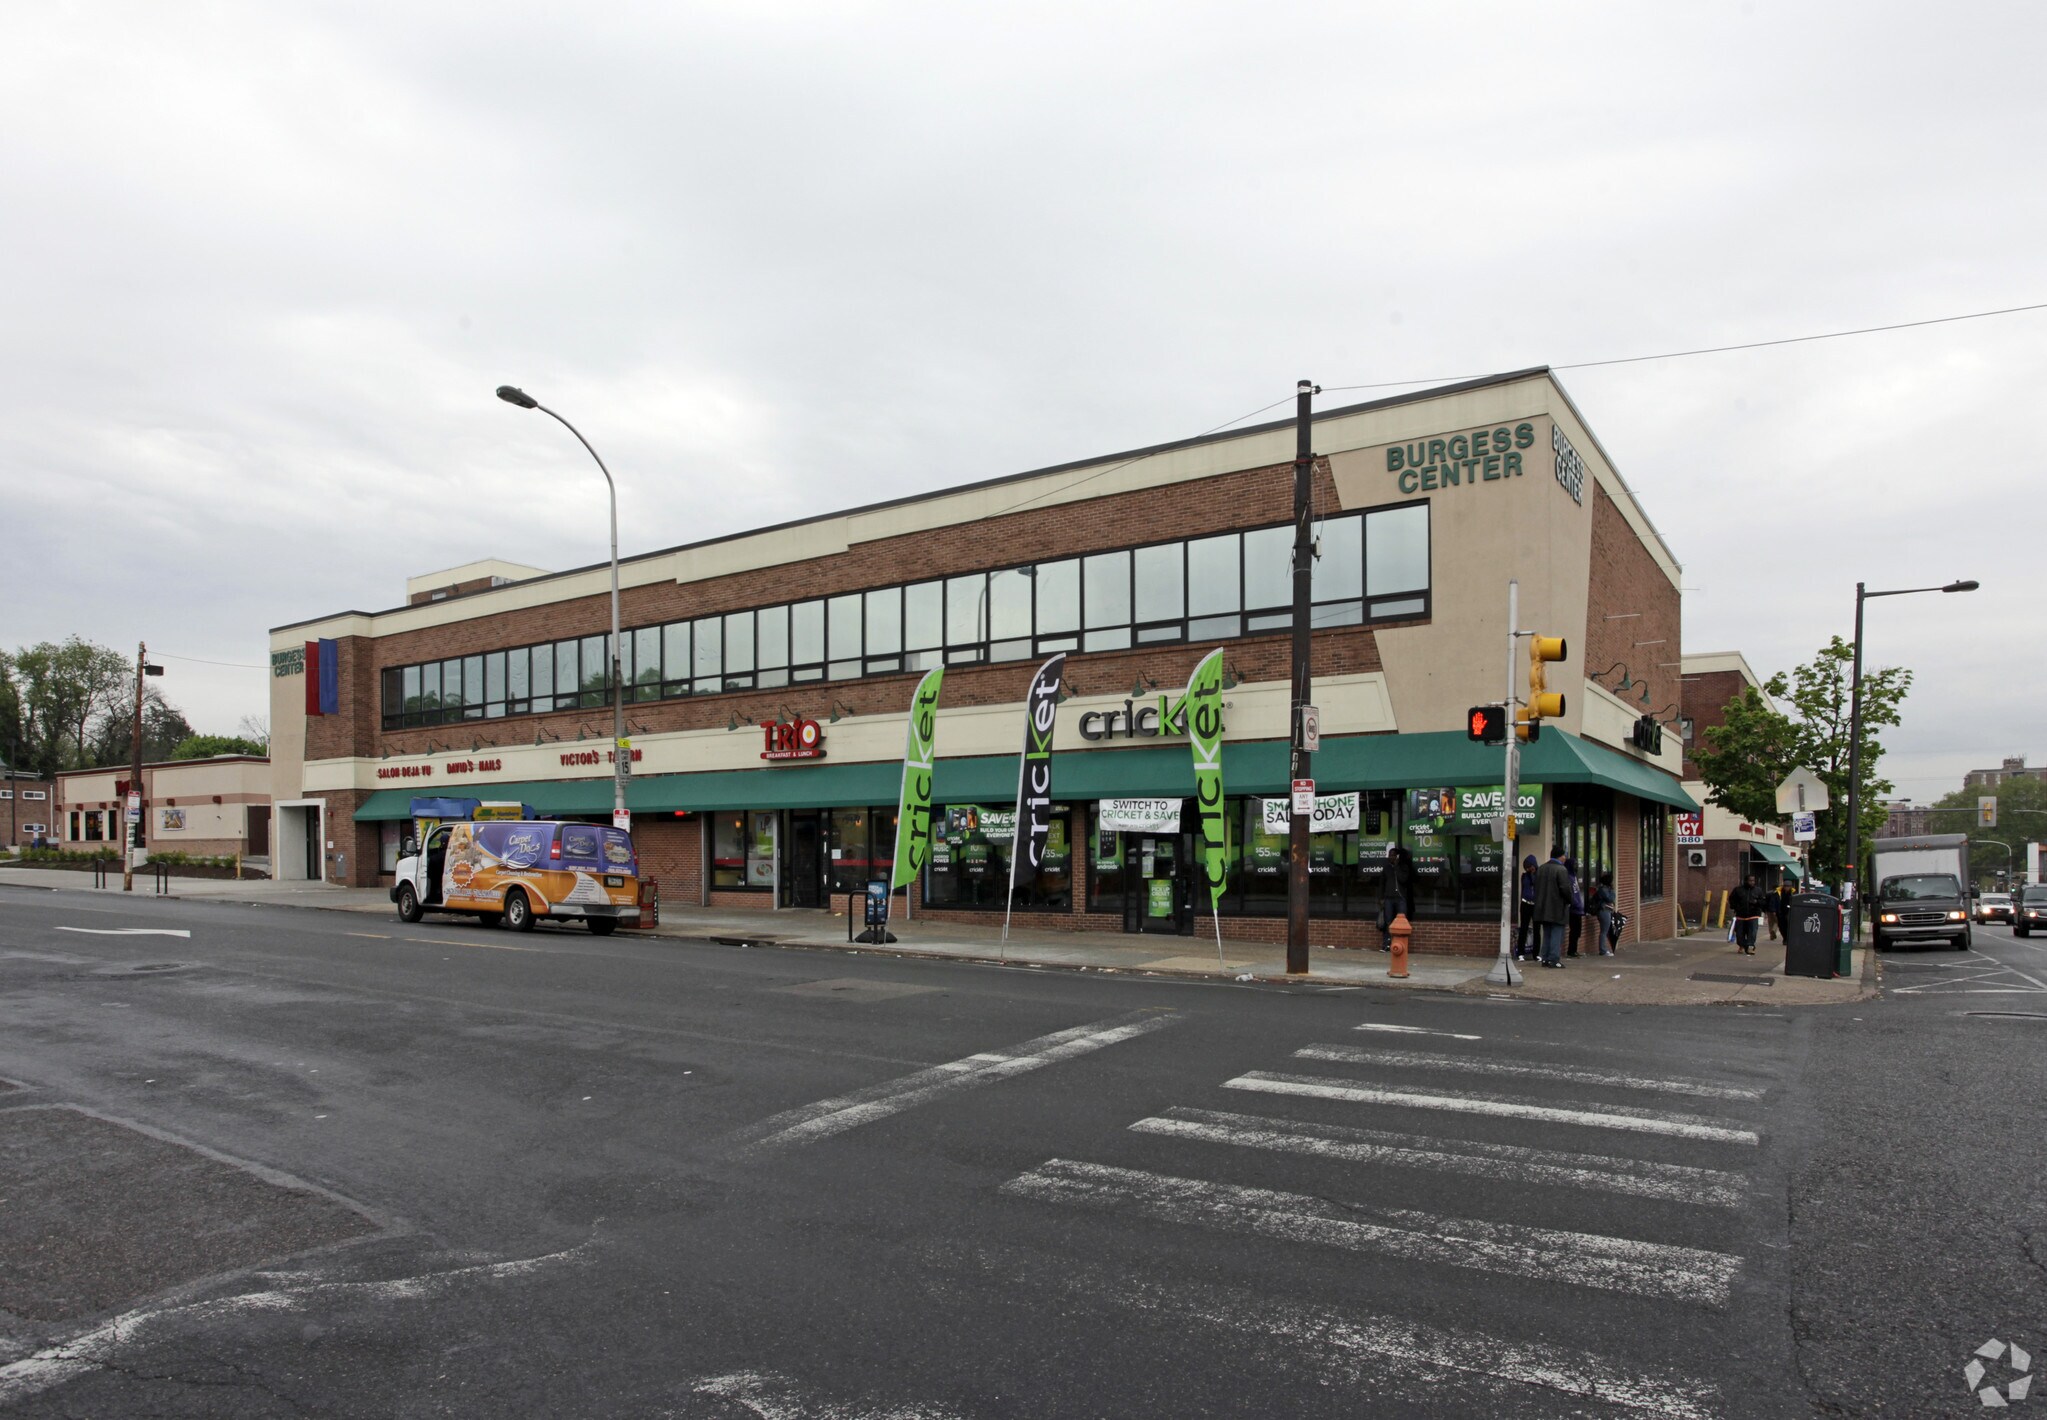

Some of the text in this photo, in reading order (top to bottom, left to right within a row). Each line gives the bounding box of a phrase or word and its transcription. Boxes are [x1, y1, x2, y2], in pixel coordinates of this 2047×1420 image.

[1387, 423, 1535, 471] BURGESS
[1552, 424, 1584, 486] BURGESS
[1398, 452, 1523, 494] CENTER
[1555, 455, 1582, 507] CENTER
[275, 661, 304, 677] CENTER
[1079, 695, 1225, 741] crick
[560, 750, 599, 766] VICTOR'S
[766, 752, 791, 760] BREAKFAST
[798, 750, 813, 758] LUNCH
[378, 765, 432, 779] SALON DEJA VU
[447, 759, 501, 774] DAVID'S NAILS
[622, 761, 629, 774] 15
[1113, 800, 1168, 811] SWITCH TO
[1462, 790, 1502, 808] SAVE
[981, 813, 1009, 824] SAVE
[1101, 809, 1180, 821] CRICKET & SAVE
[1266, 807, 1355, 824] SAL ODAY
[509, 834, 532, 846] Carpet
[1418, 865, 1439, 874] cricket
[1476, 864, 1498, 873] cricket
